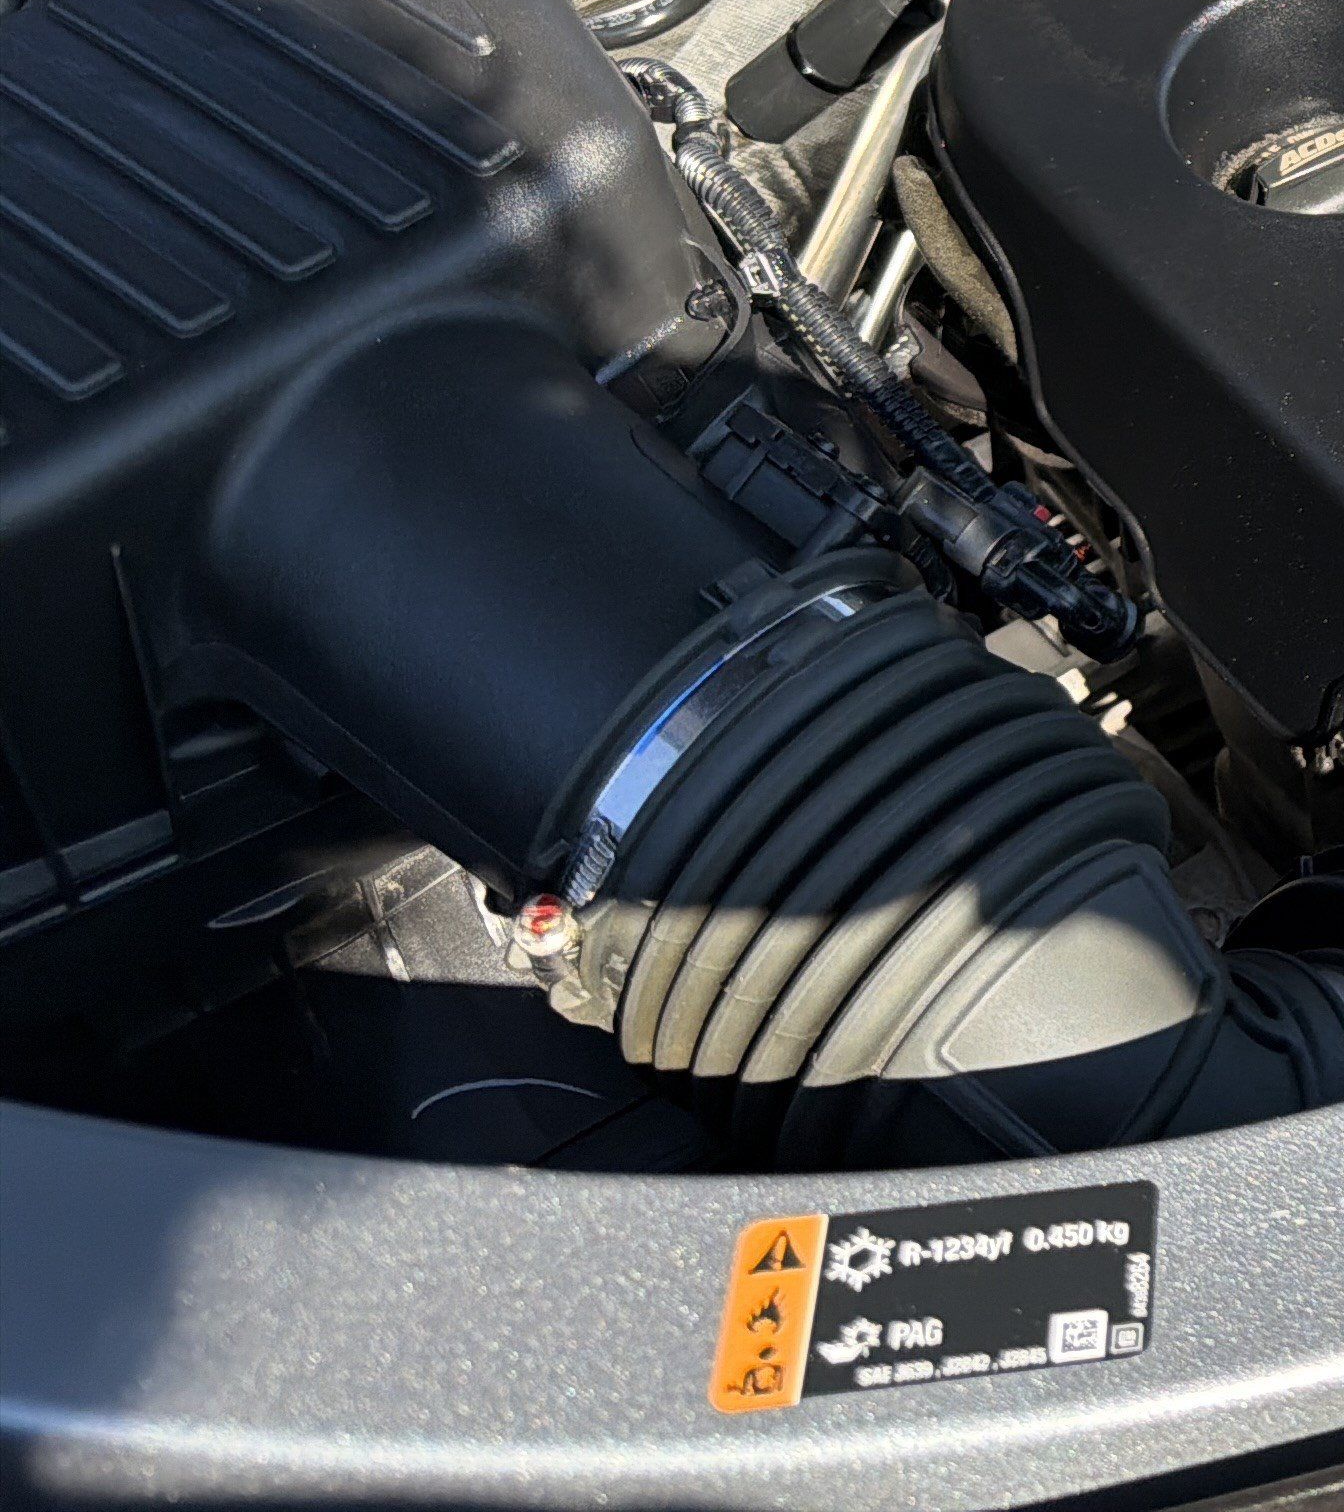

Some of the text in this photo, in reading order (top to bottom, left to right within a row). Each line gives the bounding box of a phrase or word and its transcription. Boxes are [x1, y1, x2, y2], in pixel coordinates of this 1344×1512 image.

[898, 1220, 1130, 1267] R-1234yf 0.450 kg
[887, 1318, 944, 1350] PAG
